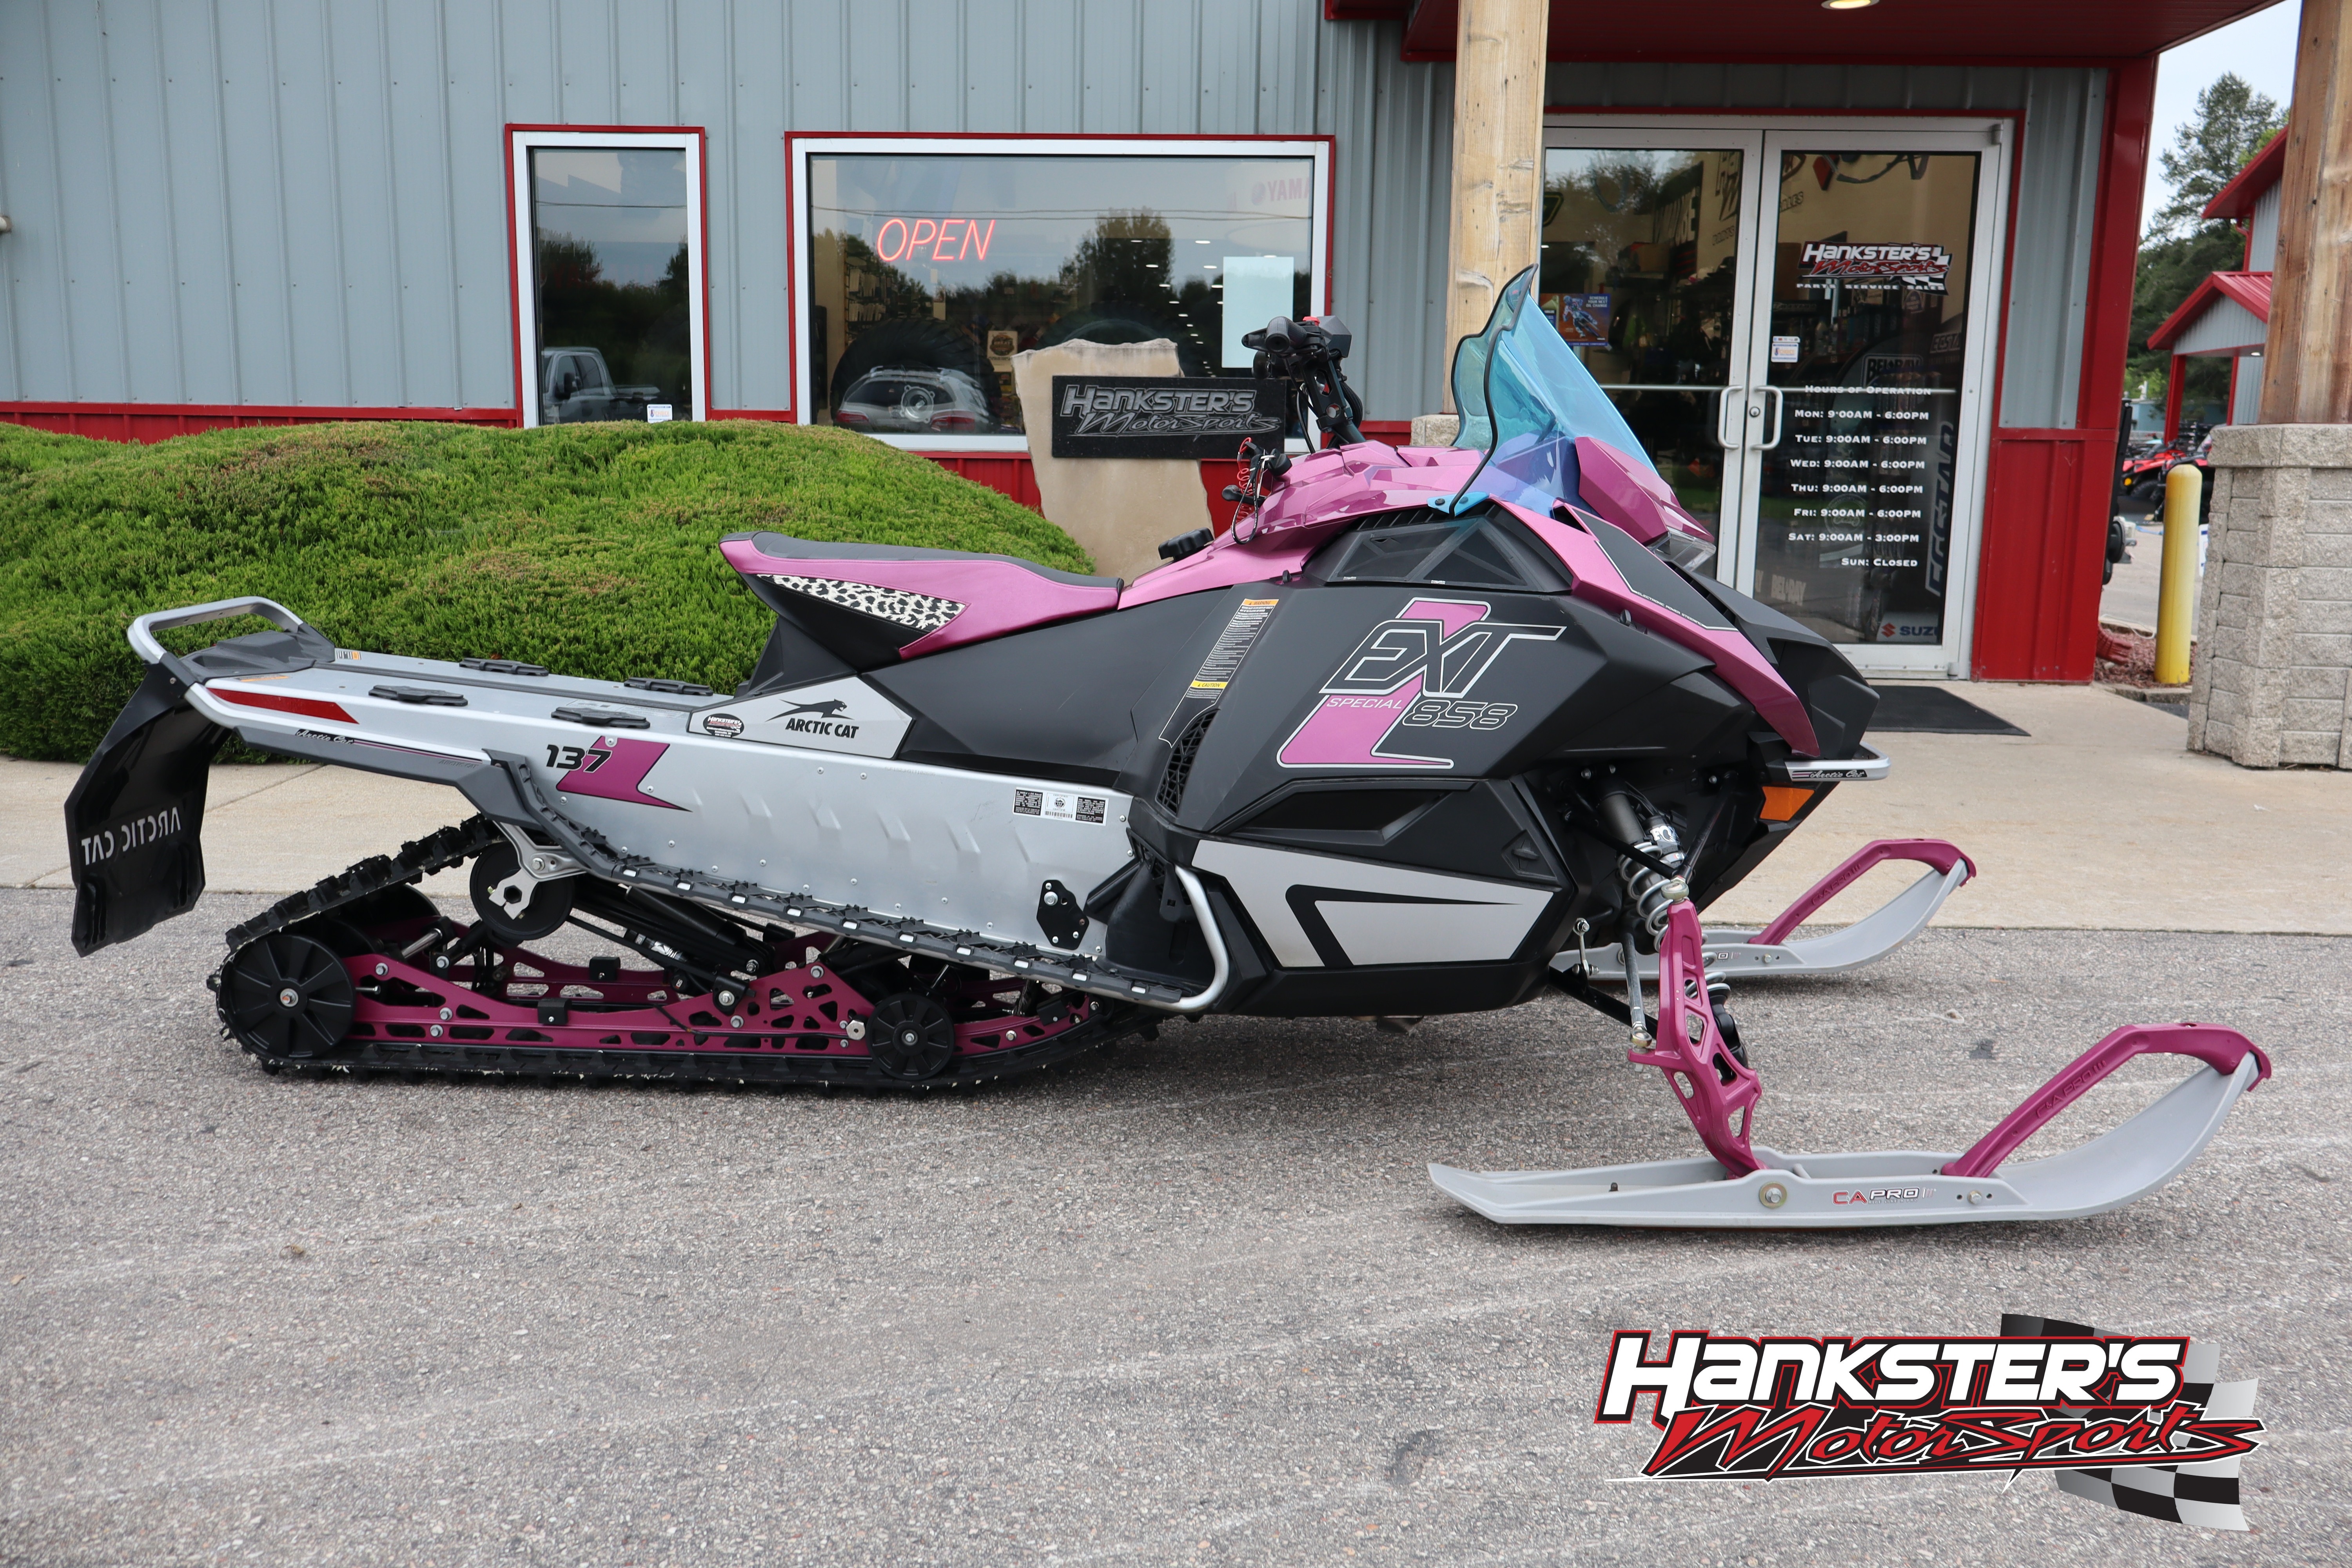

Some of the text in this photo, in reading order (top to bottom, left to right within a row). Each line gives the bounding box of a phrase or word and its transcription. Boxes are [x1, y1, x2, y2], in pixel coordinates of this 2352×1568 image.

[877, 218, 996, 262] OPEN
[1805, 385, 1844, 394] HOURS
[1866, 386, 1931, 395] OPERATION
[1795, 409, 1824, 418] MON:
[1827, 410, 1872, 419] 9:00AM
[1884, 411, 1929, 420] 6:00PM
[1795, 434, 1822, 443] TUE:
[1826, 435, 1871, 444] 9:00AM
[1882, 436, 1927, 445] 6:00PM
[1790, 459, 1820, 468] WED:
[1824, 460, 1869, 468] 9:00AM
[1880, 460, 1925, 469] 6:00PM
[1791, 483, 1818, 492] THU:
[1822, 484, 1867, 493] 9:00AM
[1879, 485, 1924, 494] 6:00PM
[1793, 508, 1817, 517] FRI:
[1820, 509, 1865, 517] 9:00AM
[1877, 510, 1921, 518] 6:00PM
[1788, 532, 1815, 541] SAT:
[1818, 533, 1863, 542] 9:00AM
[1875, 534, 1920, 543] 3:00PM
[1841, 558, 1918, 567] SUN: CLOSED
[1637, 592, 1665, 607] ELECTRONIC
[1665, 604, 1681, 614] POWER
[1318, 619, 1567, 699] EXT
[1326, 698, 1403, 709] SPECIAL
[1402, 699, 1518, 730] 858
[785, 717, 859, 739] ARCTIC CAT
[296, 730, 354, 744] Arctic Cat
[546, 744, 613, 773] 137
[1845, 769, 1865, 778] Cat
[2063, 1070, 2092, 1097] PRO
[1869, 1187, 1919, 1200] PRO
